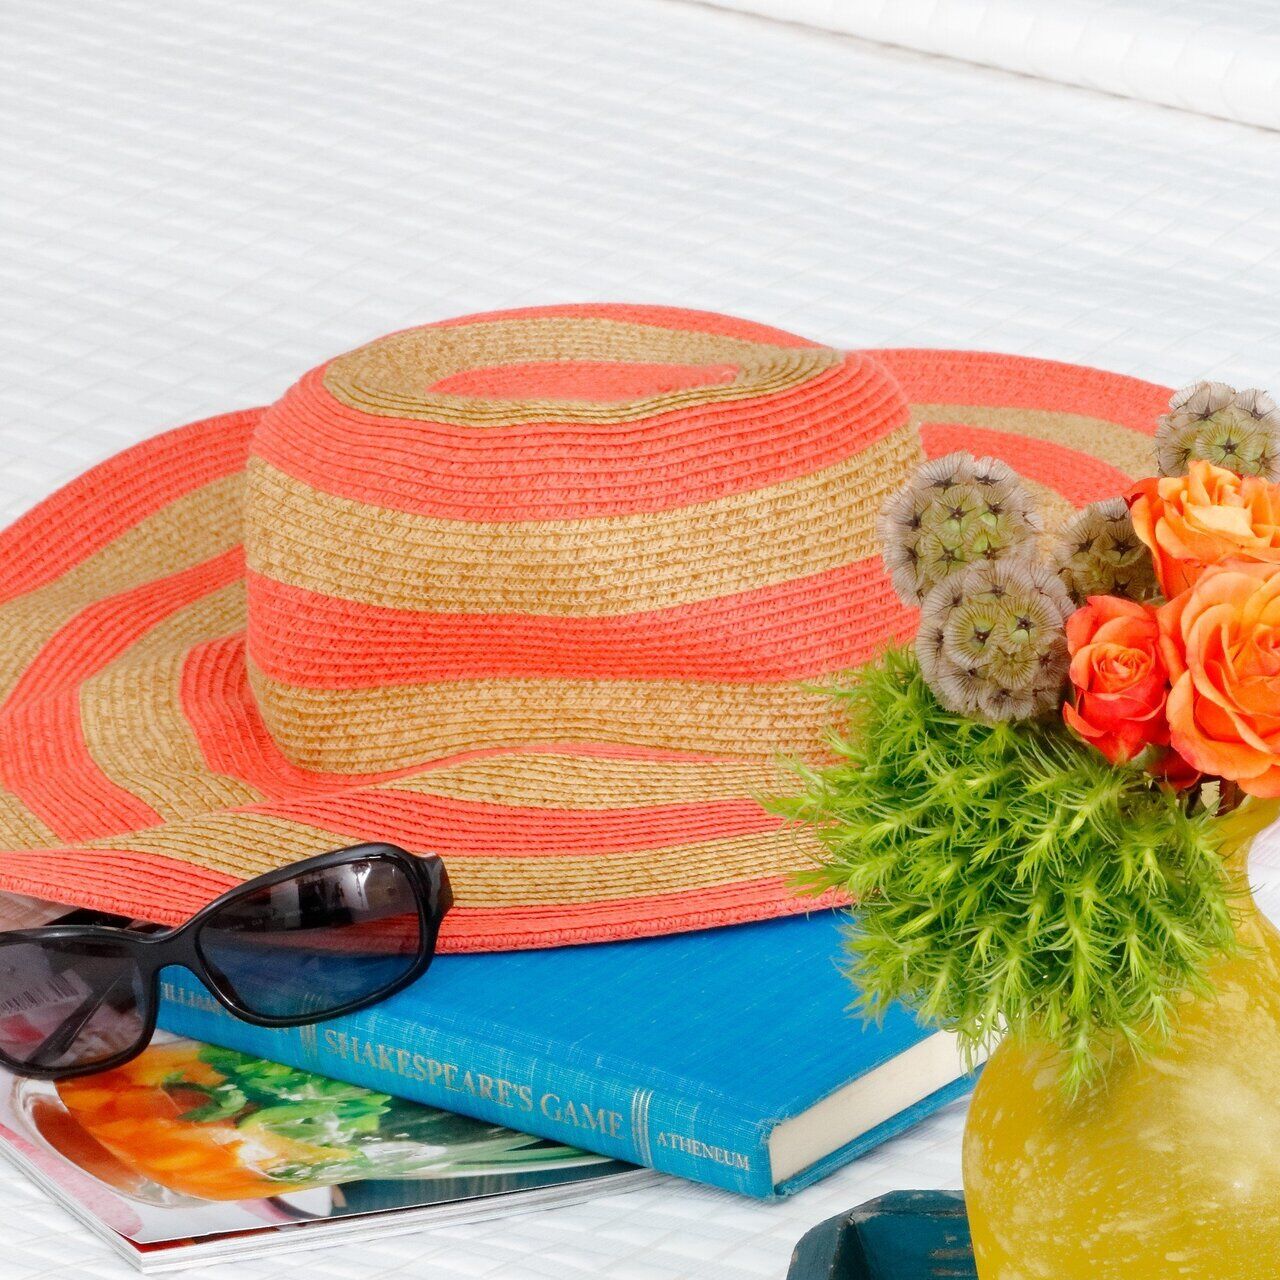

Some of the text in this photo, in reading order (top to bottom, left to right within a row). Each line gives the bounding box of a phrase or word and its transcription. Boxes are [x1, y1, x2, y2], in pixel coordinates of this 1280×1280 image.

[323, 1029, 750, 1171] SHAKESPEARE'S GAME ATHENEUM
